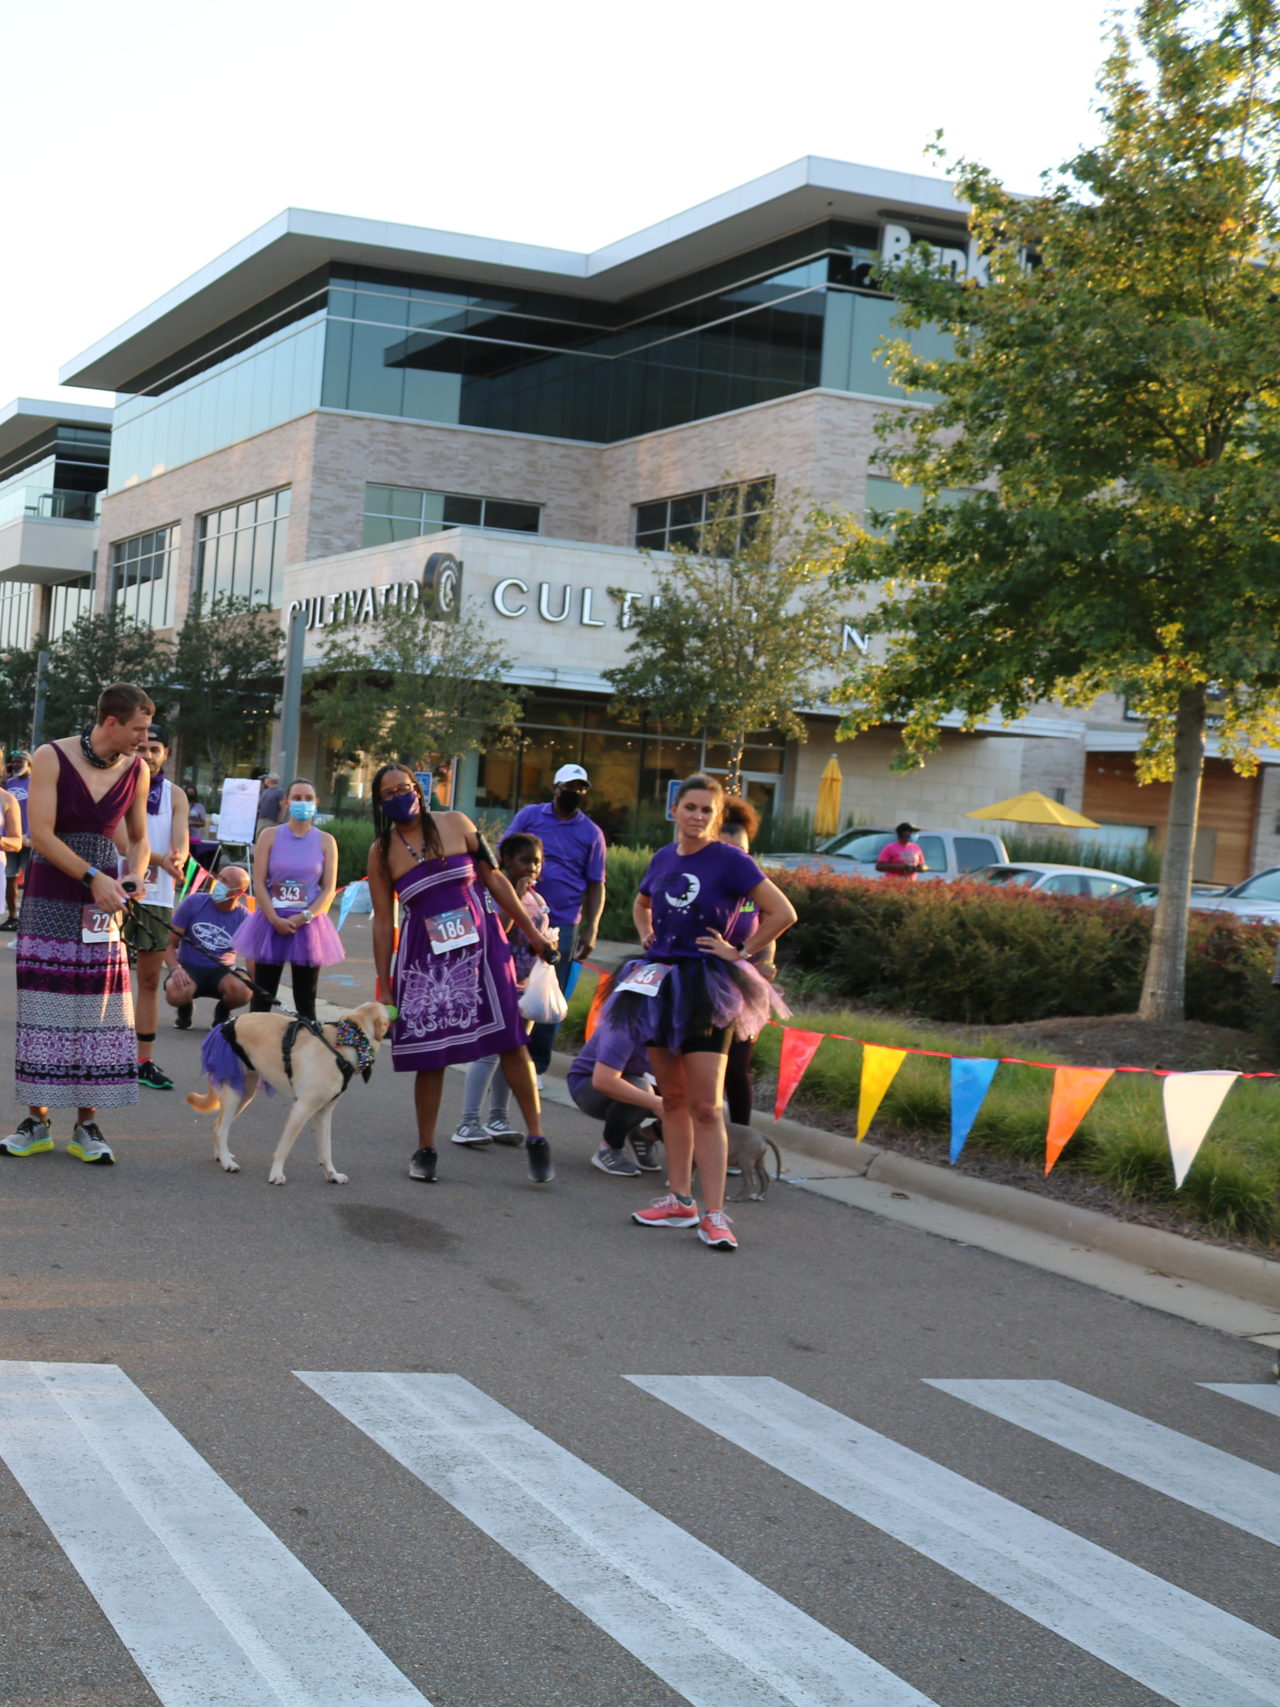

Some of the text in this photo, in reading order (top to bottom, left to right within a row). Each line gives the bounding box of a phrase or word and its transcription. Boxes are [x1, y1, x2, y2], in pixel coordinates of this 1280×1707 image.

[287, 579, 422, 630] CULTIVATIO
[279, 886, 300, 901] 343
[92, 912, 116, 932] 22
[437, 918, 466, 941] 186
